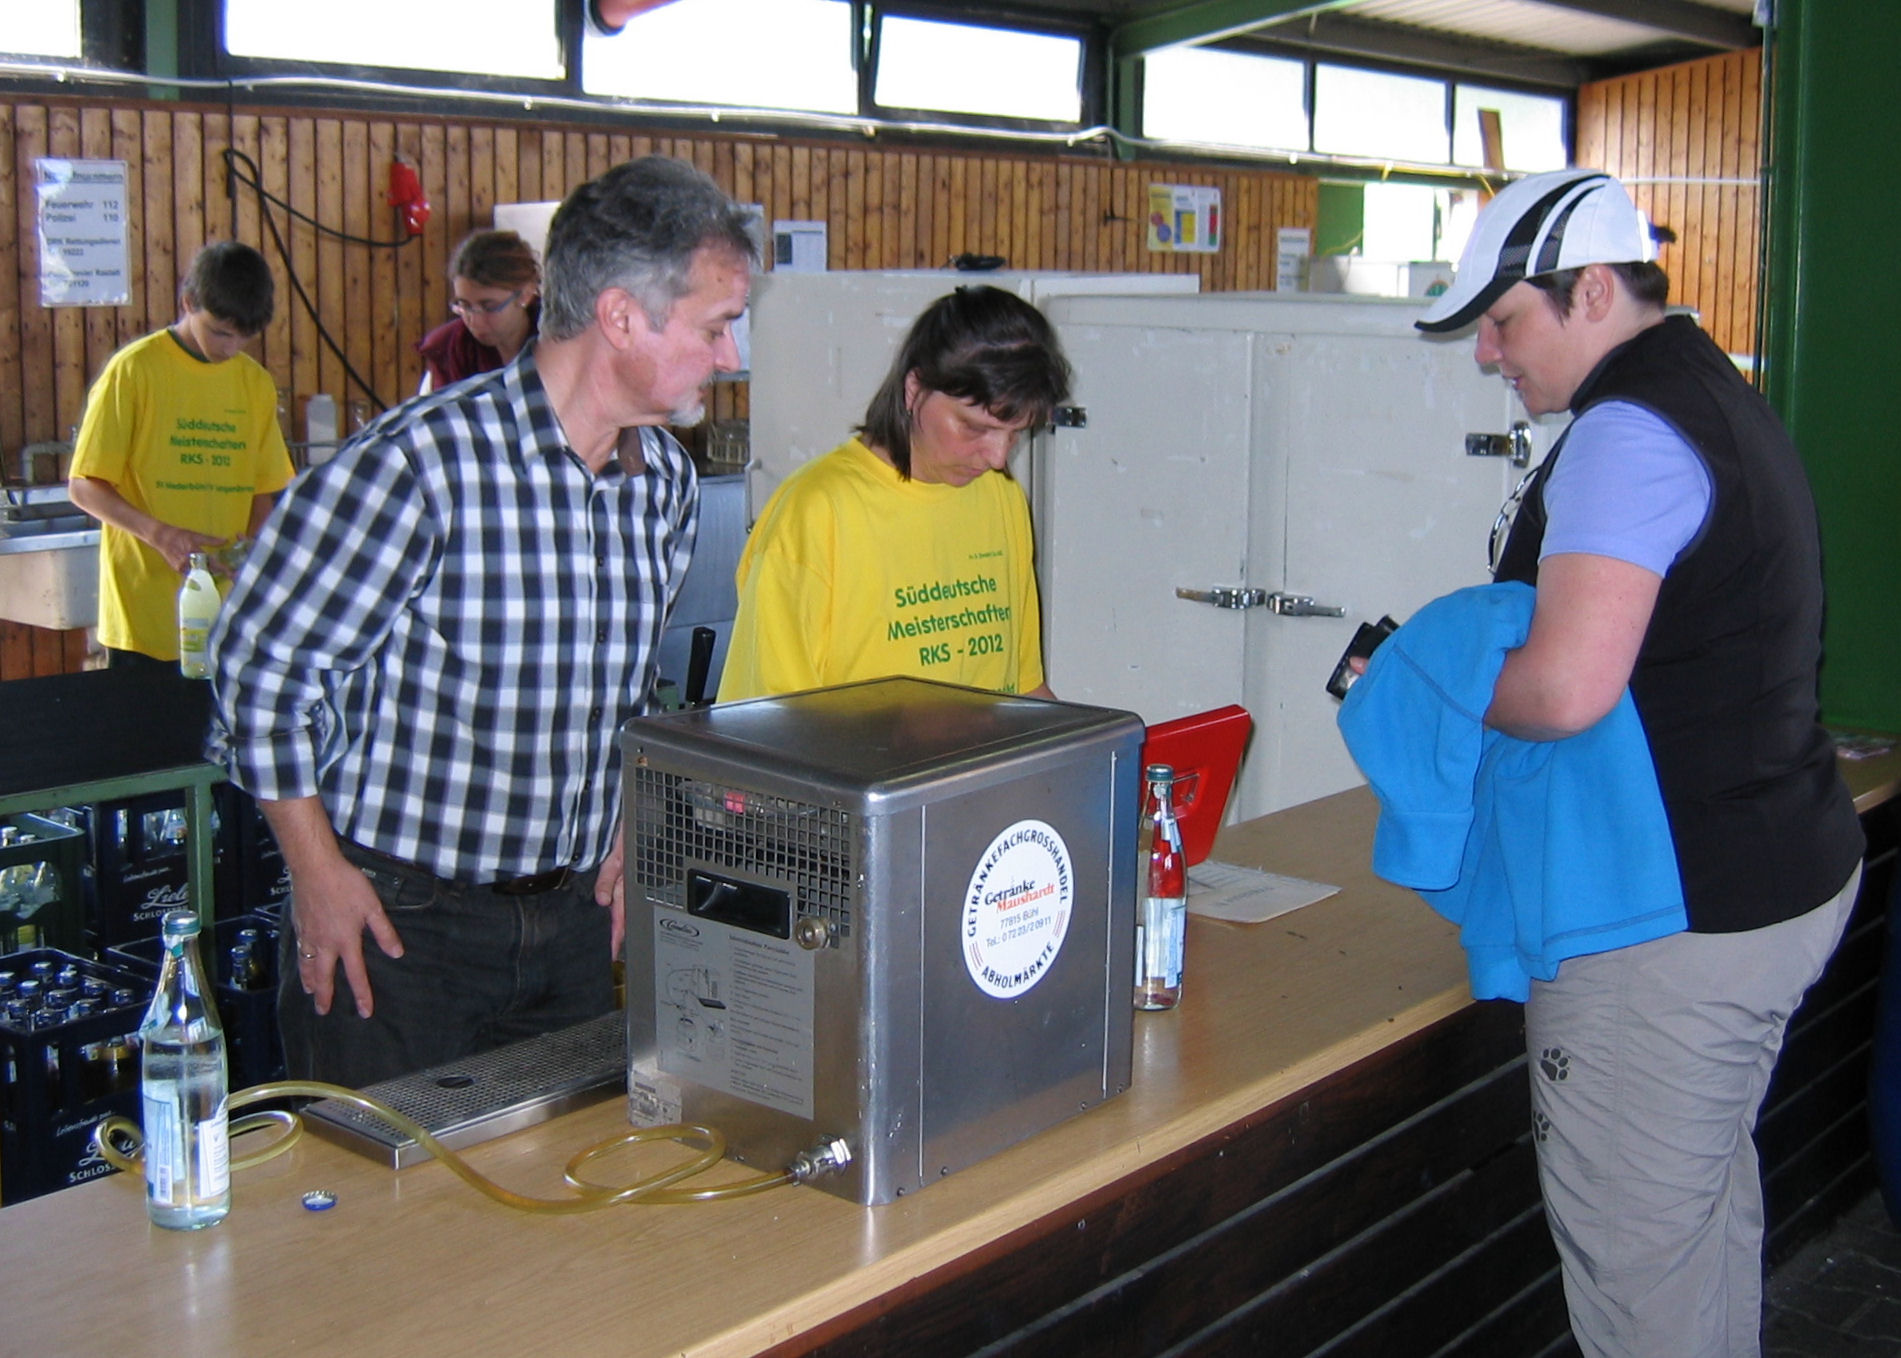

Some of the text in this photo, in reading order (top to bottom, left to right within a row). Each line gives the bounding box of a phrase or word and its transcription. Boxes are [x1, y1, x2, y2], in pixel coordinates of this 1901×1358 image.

[103, 200, 119, 209] 112
[103, 213, 119, 222] 110
[177, 418, 236, 433] Süddeutsche
[169, 435, 246, 450] Meisterschaften
[181, 453, 203, 465] RKS
[894, 574, 997, 608] Süddeutsche
[919, 643, 951, 666] RKS
[968, 633, 1004, 656] 2012
[967, 829, 1068, 938] GETRÄNKEFACHGROSSHANDEL
[984, 879, 1036, 905] Getränke
[996, 883, 1055, 913] Maushardt
[981, 941, 1054, 989] ABHOLMÄRKTE
